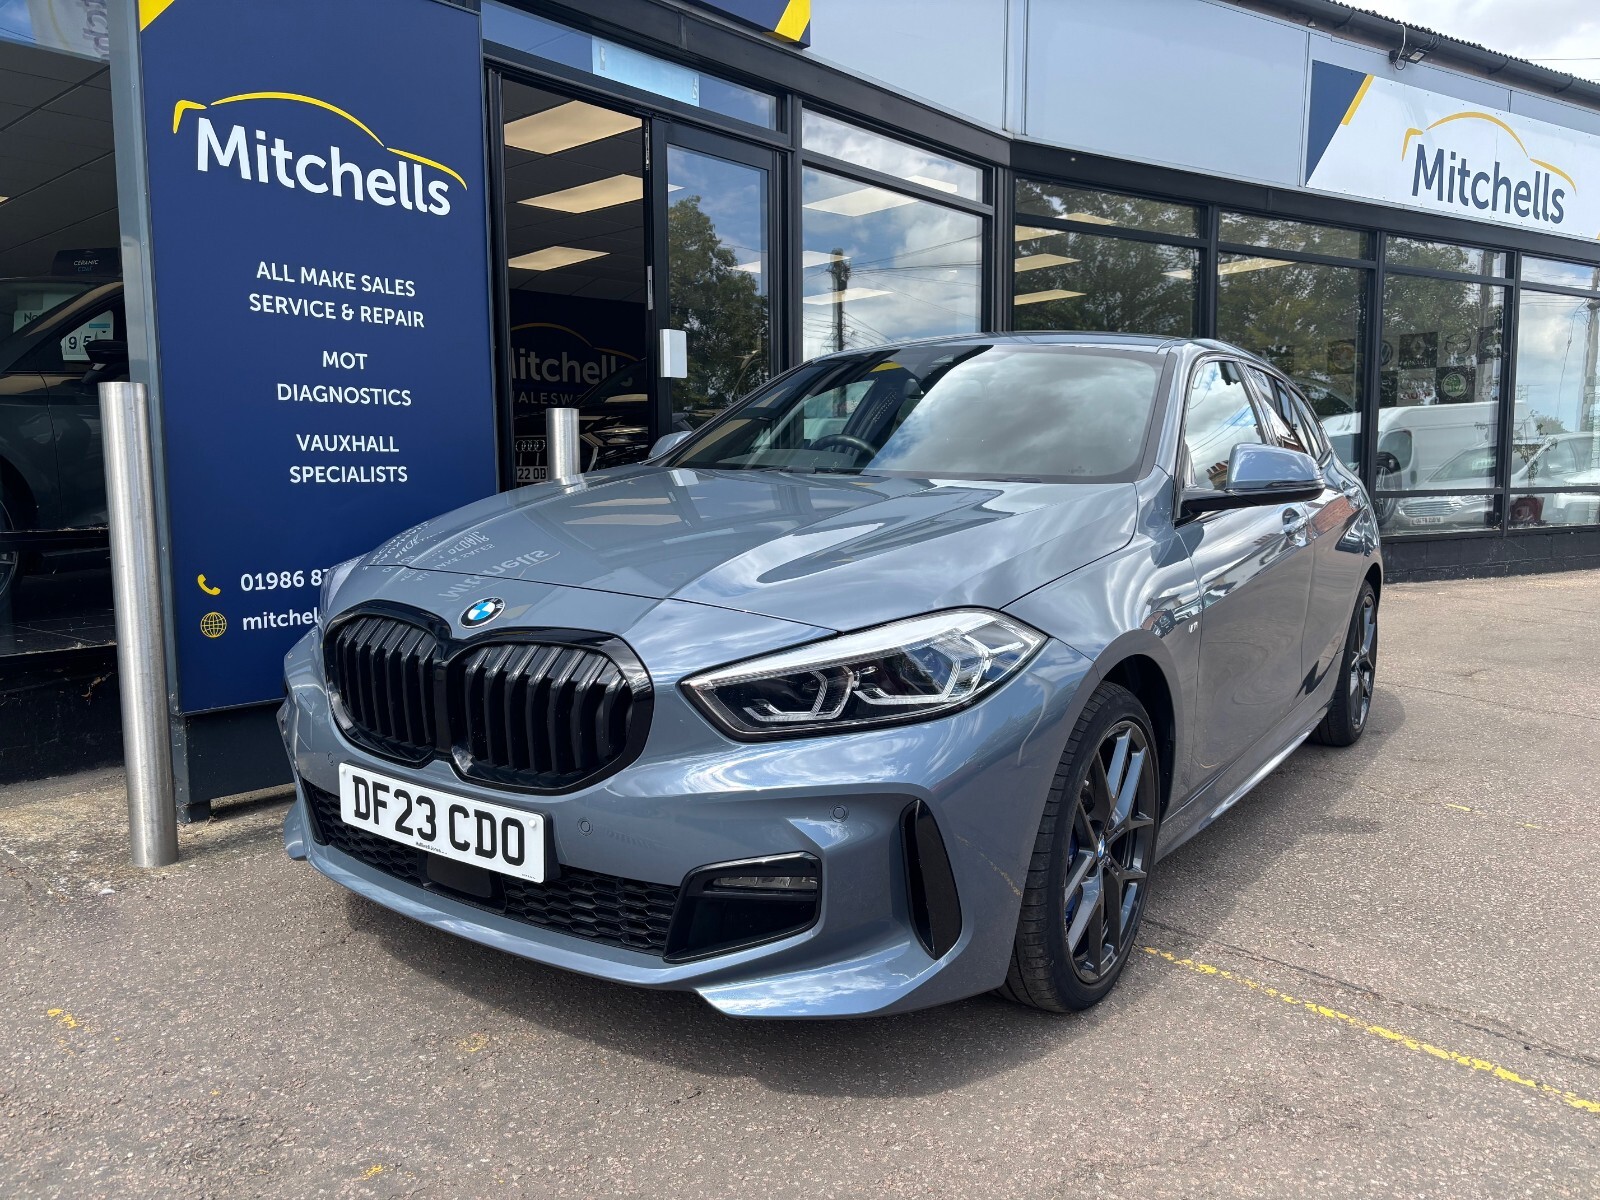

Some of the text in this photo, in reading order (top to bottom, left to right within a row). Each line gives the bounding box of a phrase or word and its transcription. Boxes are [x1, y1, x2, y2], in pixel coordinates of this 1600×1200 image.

[197, 116, 451, 216] Mitchells
[1411, 143, 1566, 224] Mitchells
[256, 261, 416, 297] ALL MAKE SALES
[249, 293, 425, 328] SERVICE & REPAIR
[322, 350, 368, 369] MOT
[277, 383, 412, 406] DIAGNOSTICS
[295, 434, 400, 452] VAUXHALL
[289, 466, 408, 483] SPECIALISTS
[518, 468, 530, 480] 22
[240, 570, 305, 591] 01986
[352, 774, 525, 867] DF23 CDO
